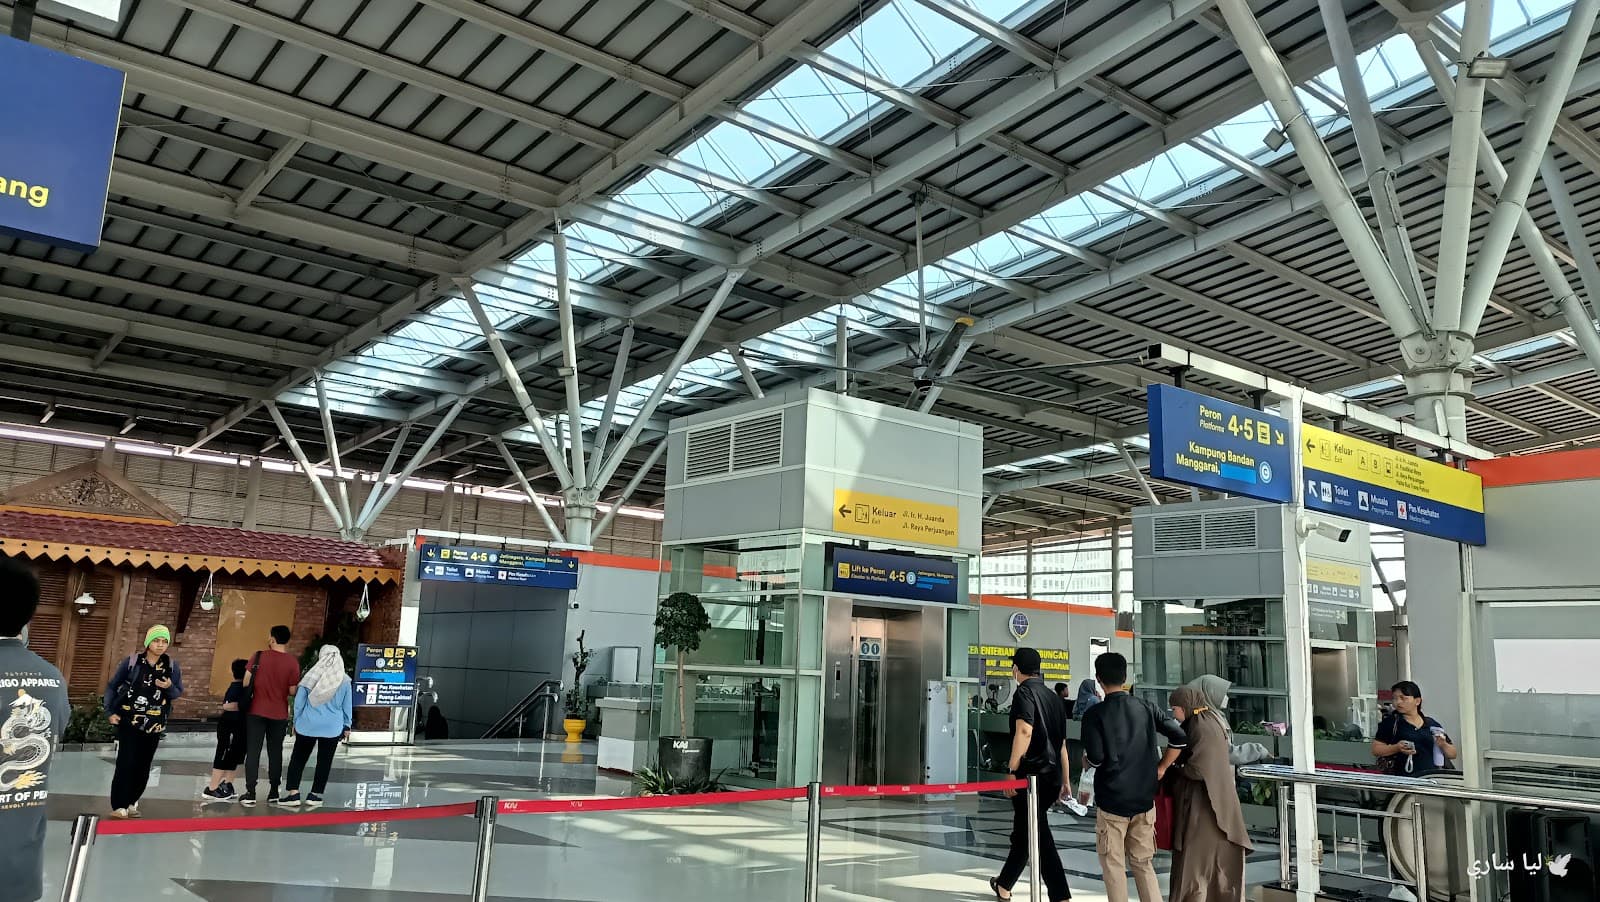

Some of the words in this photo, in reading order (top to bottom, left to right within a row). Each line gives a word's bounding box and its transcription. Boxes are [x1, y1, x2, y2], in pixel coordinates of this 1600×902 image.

[1199, 405, 1222, 421] Peron
[1199, 419, 1225, 433] Platforms
[1188, 440, 1226, 462] Kampung
[1227, 450, 1255, 467] Bandan
[1334, 443, 1353, 456] Keluar
[1176, 453, 1221, 476] Manggarai,
[1334, 485, 1349, 497] Toilet
[872, 506, 897, 518] Keluar
[917, 512, 924, 520] H.
[924, 513, 945, 524] Juanda
[902, 522, 910, 530] Jl.
[910, 523, 924, 533] Raya
[924, 525, 955, 537] Perjuangan
[870, 567, 886, 575] Peron
[14, 791, 31, 801] OF
